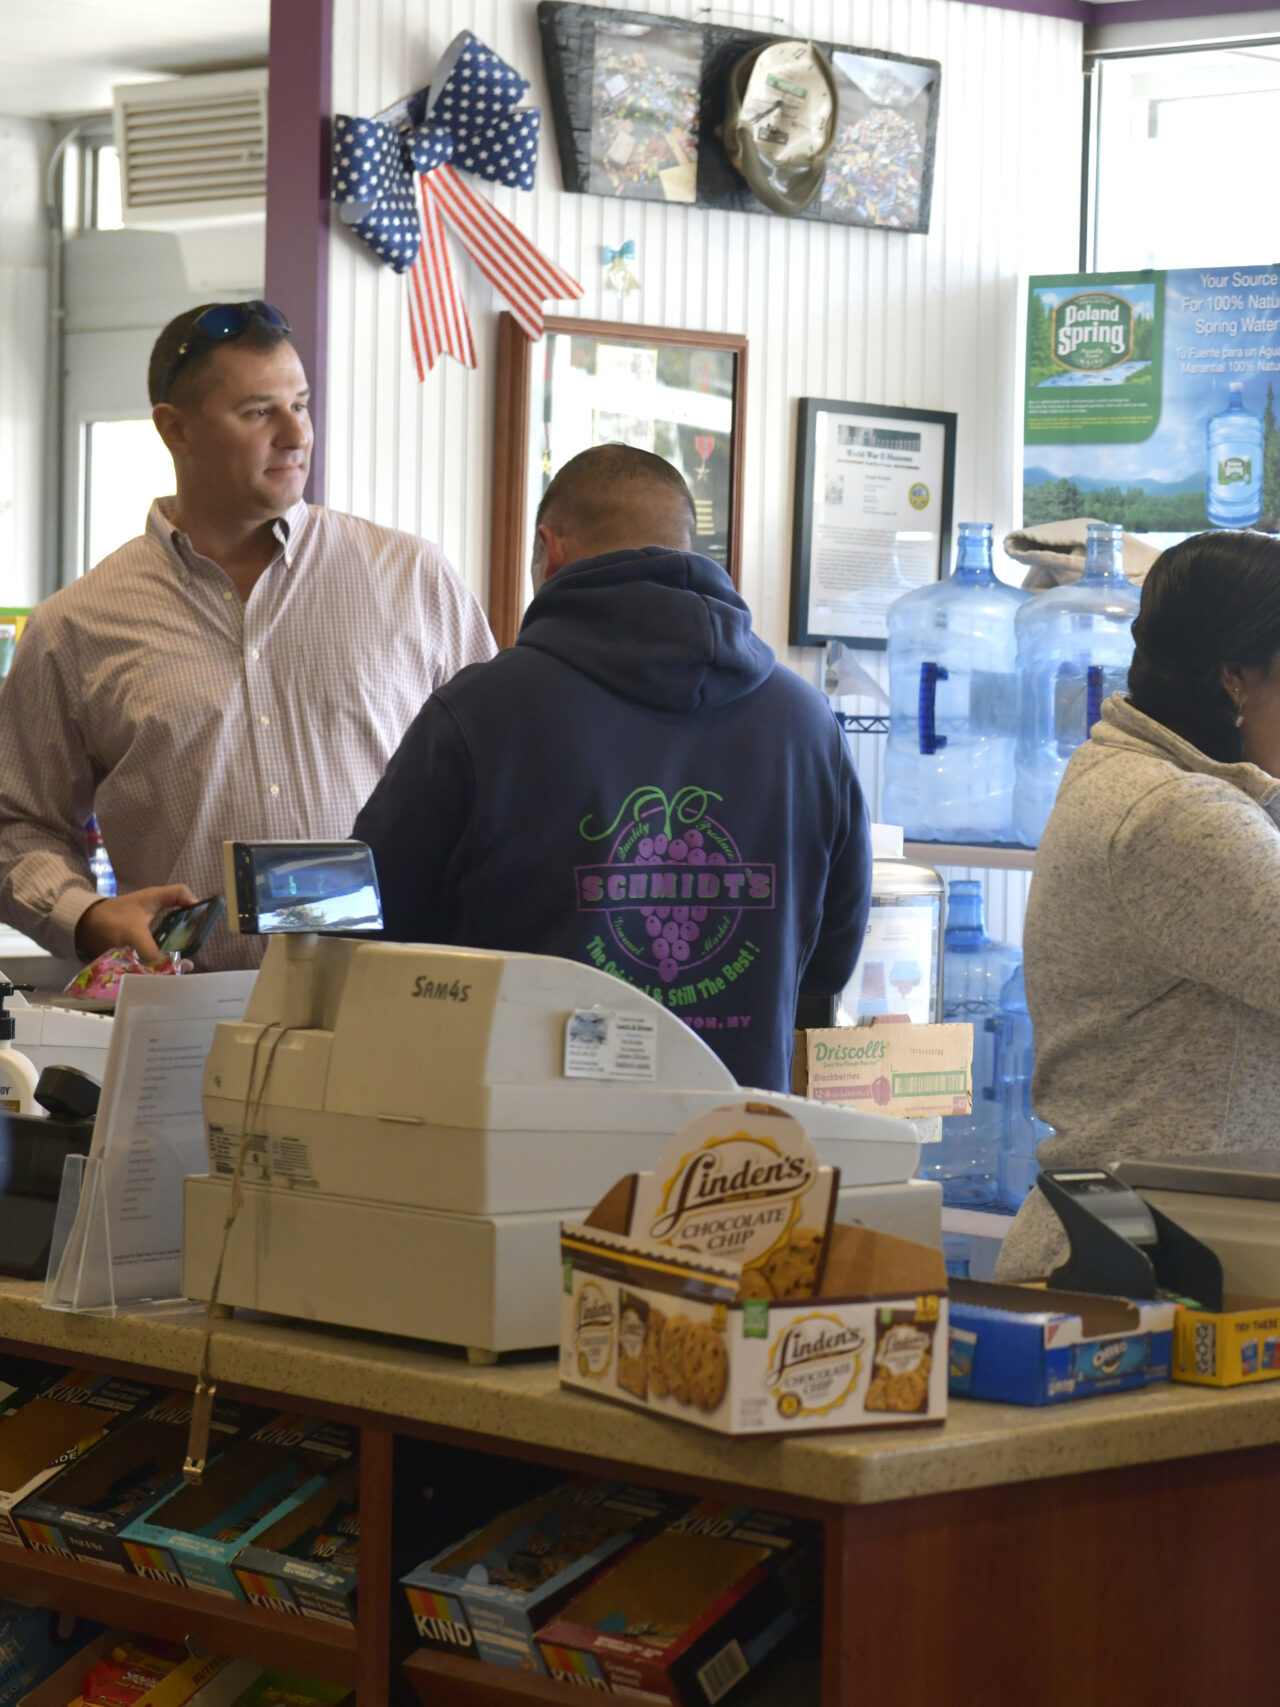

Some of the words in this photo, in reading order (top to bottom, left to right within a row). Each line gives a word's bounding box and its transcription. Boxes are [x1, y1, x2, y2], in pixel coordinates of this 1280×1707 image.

[1201, 273, 1229, 289] Your
[1232, 271, 1278, 287] Source
[1182, 297, 1204, 312] For
[1208, 294, 1244, 311] 100%
[1065, 304, 1120, 327] Poland
[1196, 319, 1237, 337] Spring
[1241, 317, 1279, 332] Water
[1057, 321, 1125, 356] Spring
[1176, 347, 1188, 359] Tu
[1190, 346, 1221, 358] Fuente
[1222, 347, 1243, 359] para
[1181, 360, 1226, 374] Manantial
[1229, 360, 1255, 372] 100%
[582, 867, 770, 901] SCHMIDT'S
[586, 935, 606, 967] The
[668, 984, 697, 1007] Still
[697, 977, 726, 999] The
[727, 1015, 752, 1029] NY
[814, 1040, 885, 1062] Driscoll's
[813, 1072, 861, 1082] Blackberries
[651, 1152, 812, 1239] Linden's
[681, 1206, 788, 1240] CHOCOLATE
[706, 1229, 756, 1251] CHIP
[1234, 1322, 1251, 1333] TRY
[1253, 1319, 1279, 1331] THESE
[766, 1326, 867, 1388] Linden's
[784, 1362, 851, 1389] CHOCOLATE
[40, 1383, 93, 1405] KIND
[802, 1380, 834, 1397] CHIP
[249, 1424, 305, 1447] KIND
[668, 1515, 735, 1538] KIND
[413, 1613, 473, 1648] KIND
